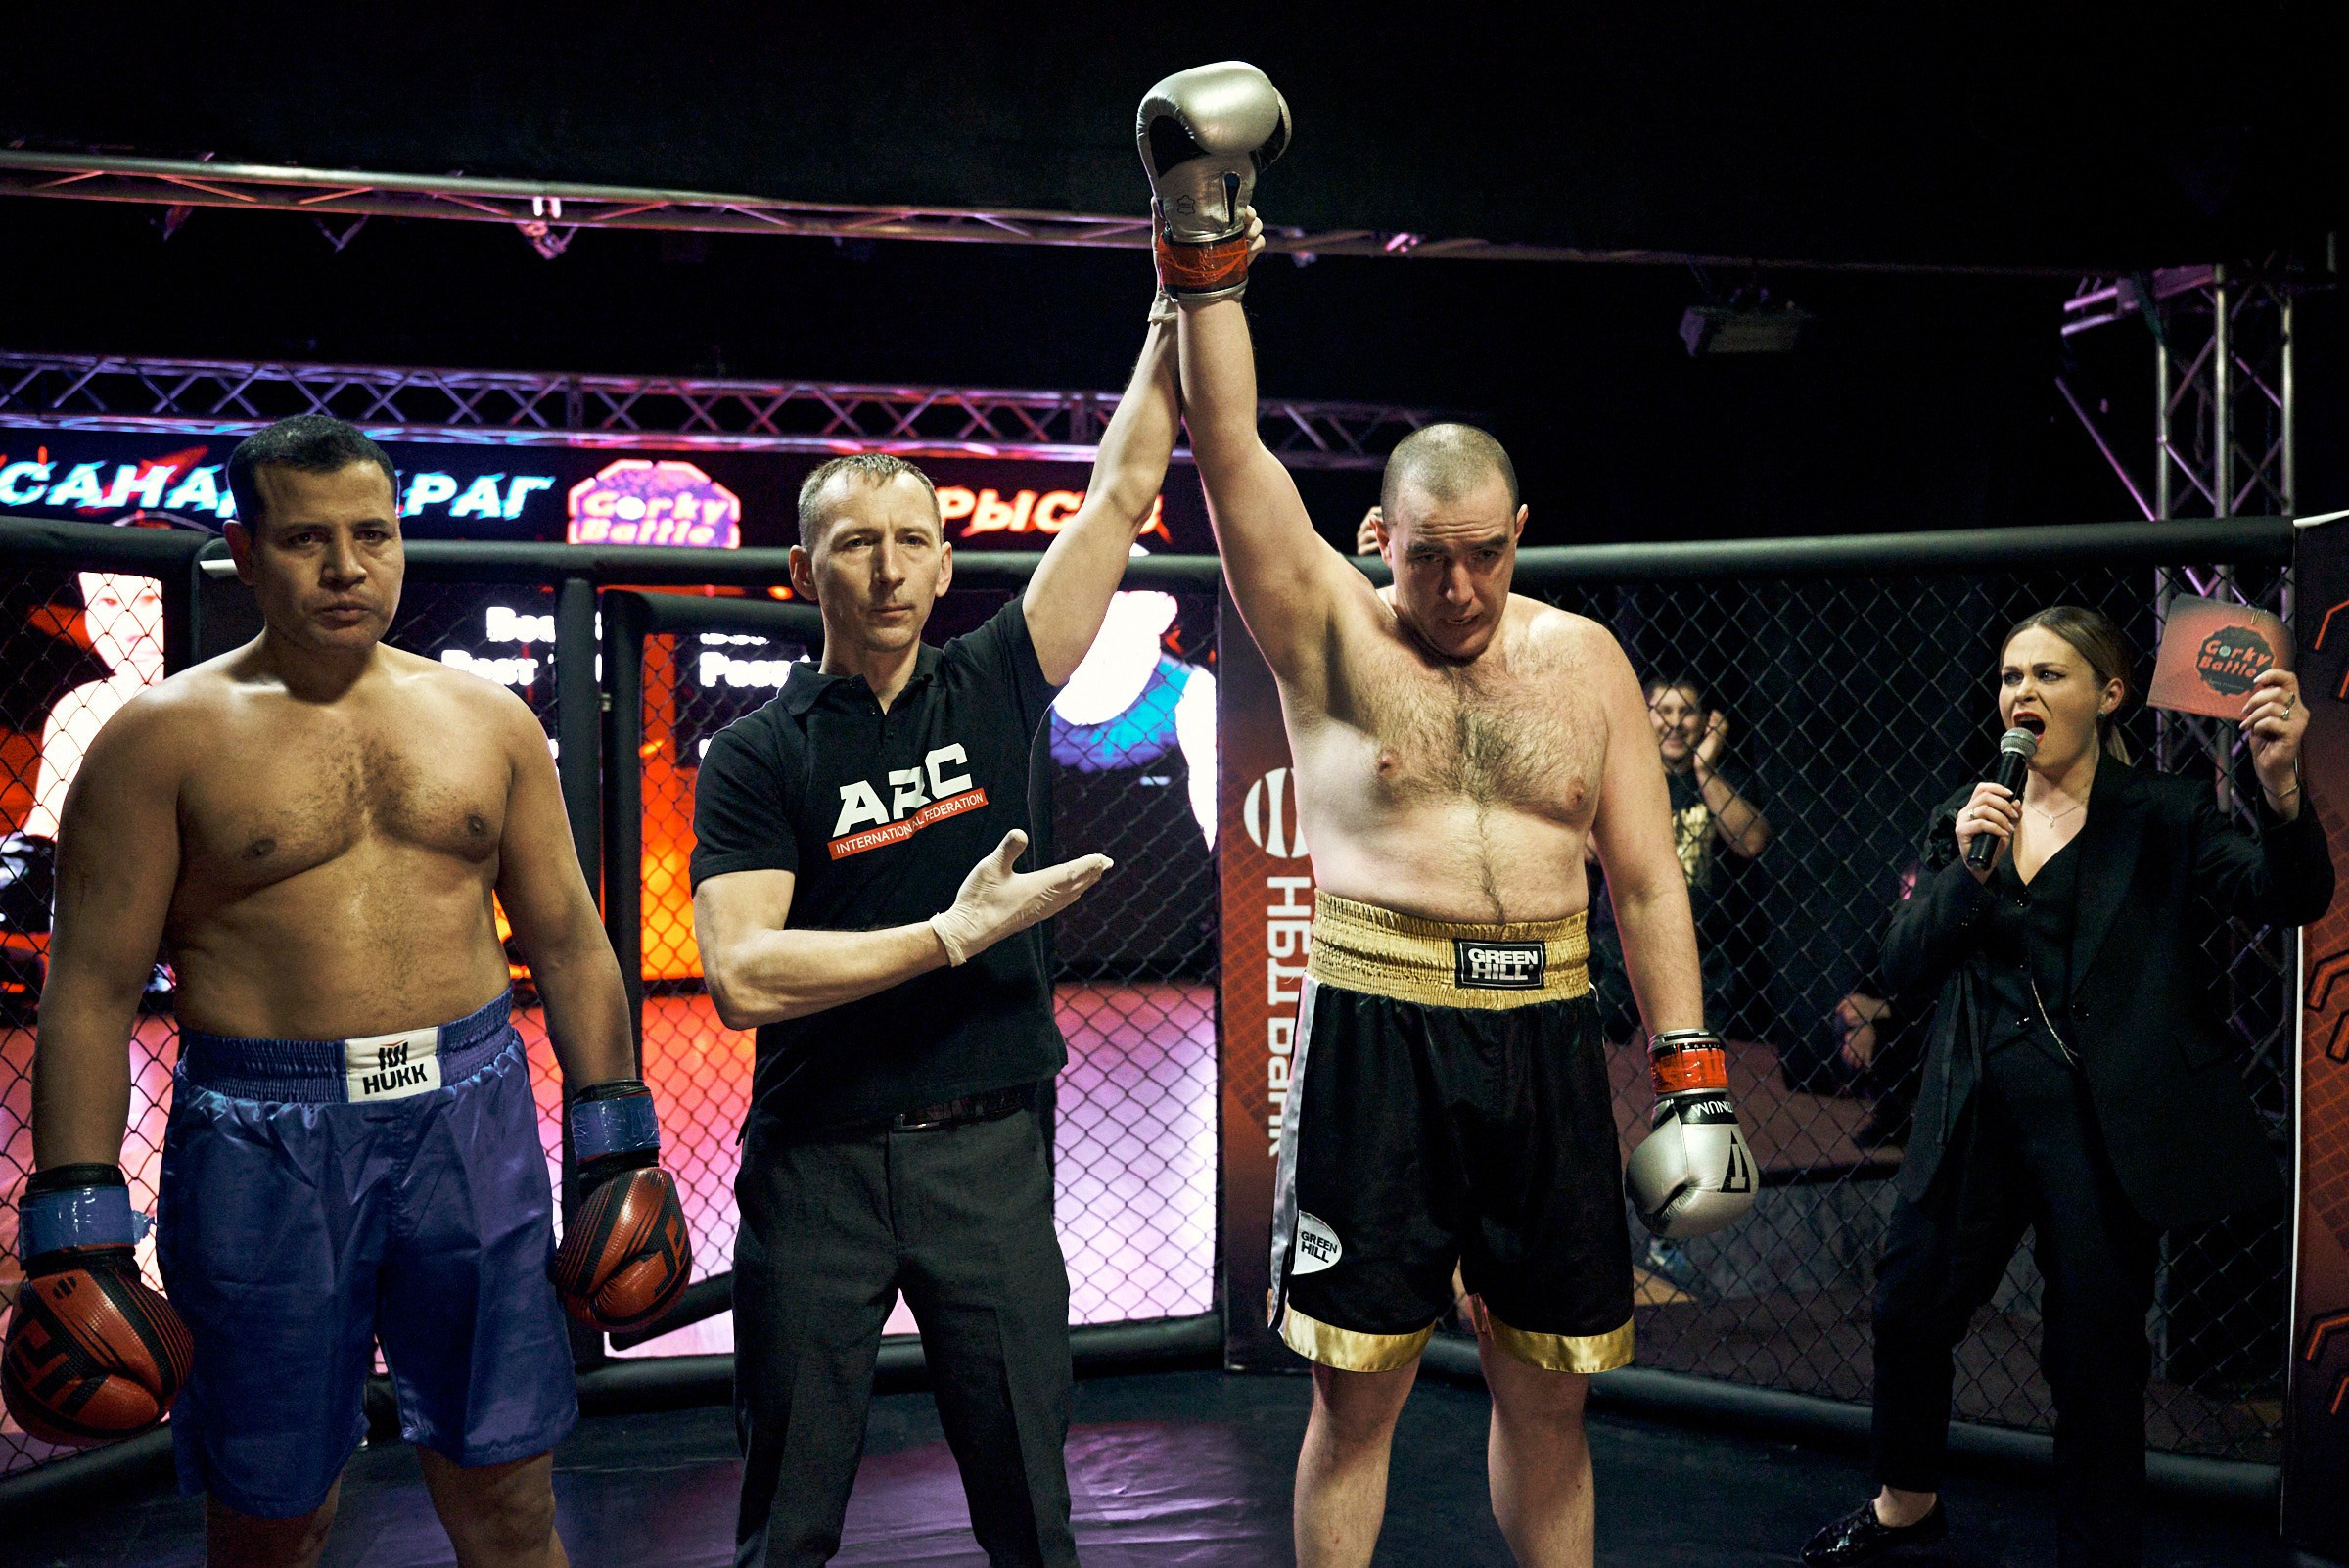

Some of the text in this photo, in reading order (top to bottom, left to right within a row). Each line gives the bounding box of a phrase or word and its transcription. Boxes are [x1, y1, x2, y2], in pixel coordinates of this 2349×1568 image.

[0, 460, 557, 521] САНА РАГ
[583, 490, 730, 526] Gorky
[578, 517, 716, 544] Battle
[2199, 656, 2257, 678] Battle
[2205, 640, 2271, 668] Gorky
[832, 742, 972, 838] ARC
[836, 792, 984, 854] INTERNATIONAL FEDERATION
[1467, 947, 1539, 965] GREEN
[1471, 960, 1529, 981] HILL
[362, 1063, 428, 1095] HUKK
[1301, 1230, 1338, 1254] GREEN
[1301, 1241, 1330, 1264] HILL
